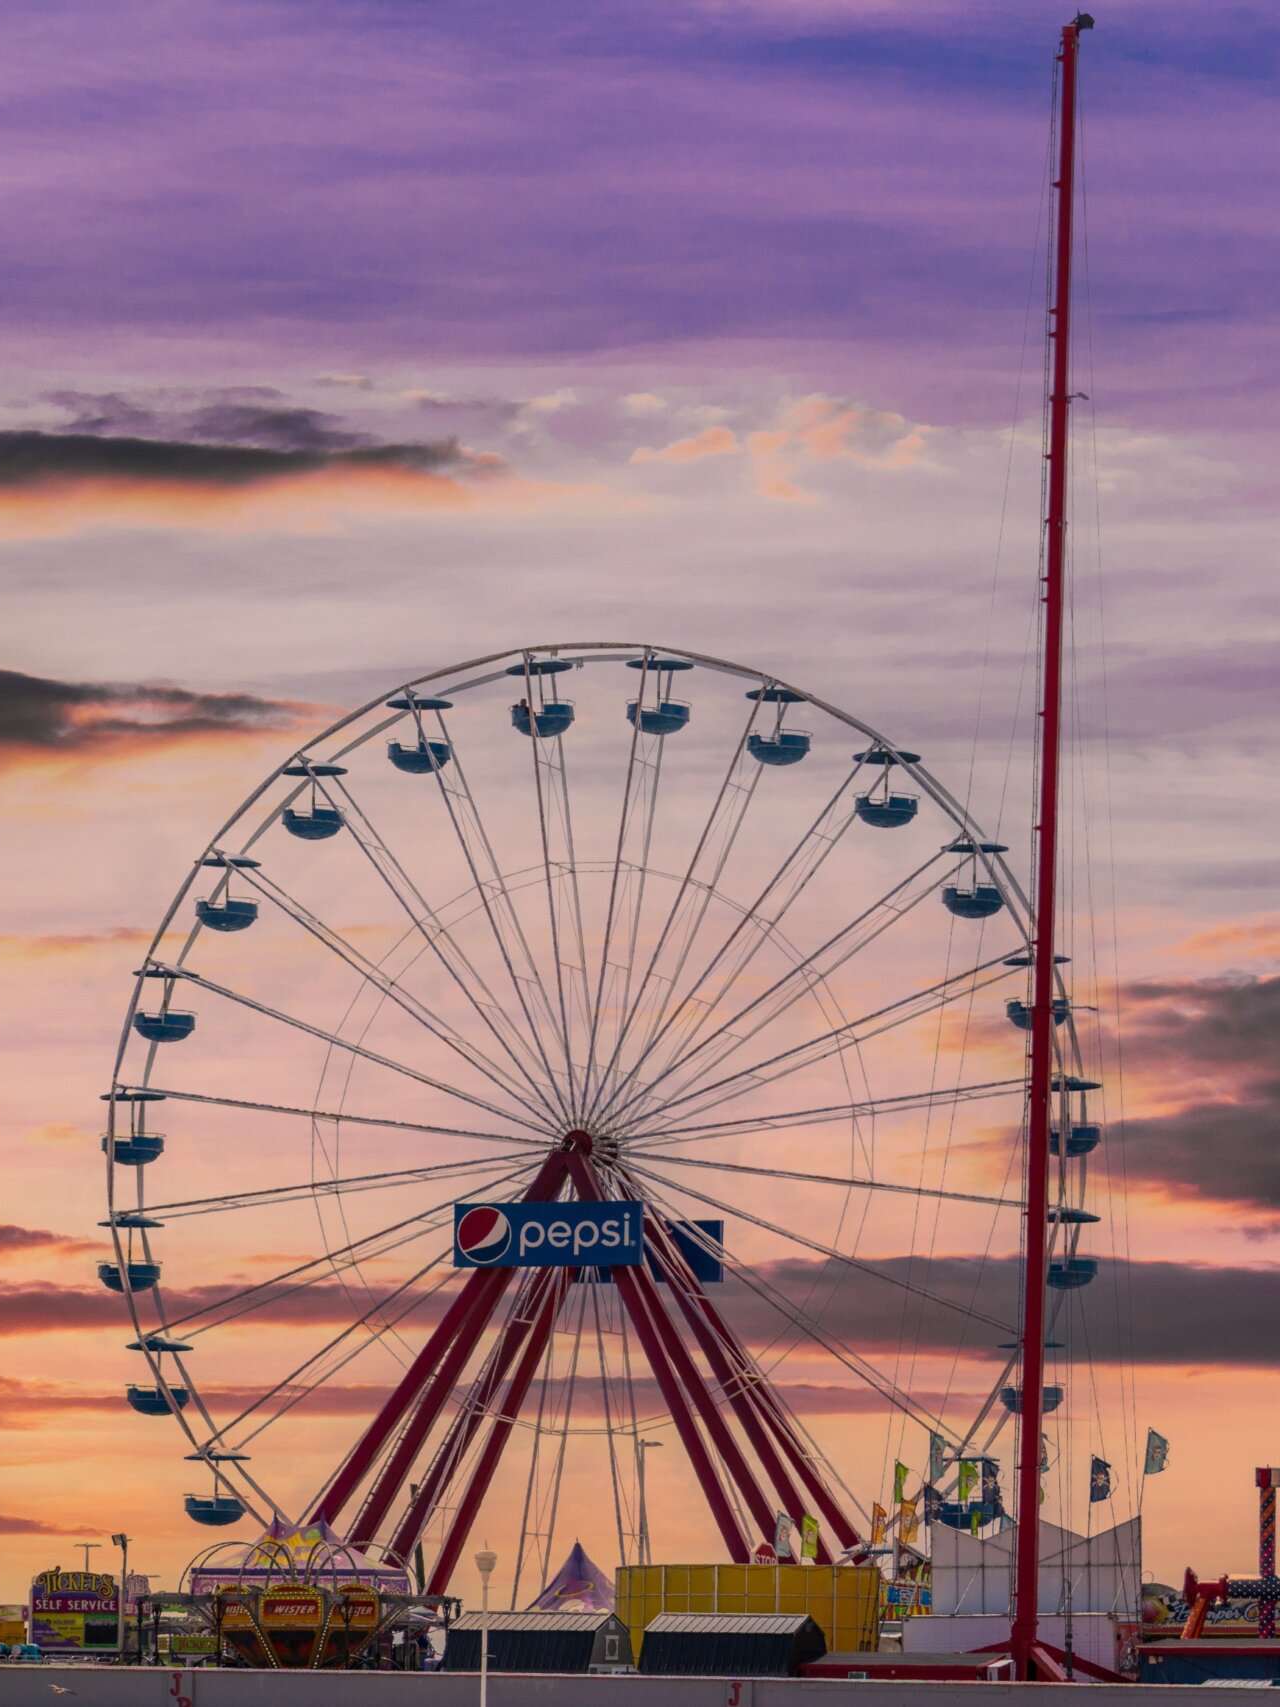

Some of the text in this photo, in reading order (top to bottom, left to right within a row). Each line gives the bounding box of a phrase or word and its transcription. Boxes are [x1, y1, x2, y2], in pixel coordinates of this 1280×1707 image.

[520, 1212, 630, 1257] pepsi
[36, 1565, 115, 1600] TICKETS
[36, 1599, 62, 1610] SELF
[68, 1600, 117, 1611] SERVICE
